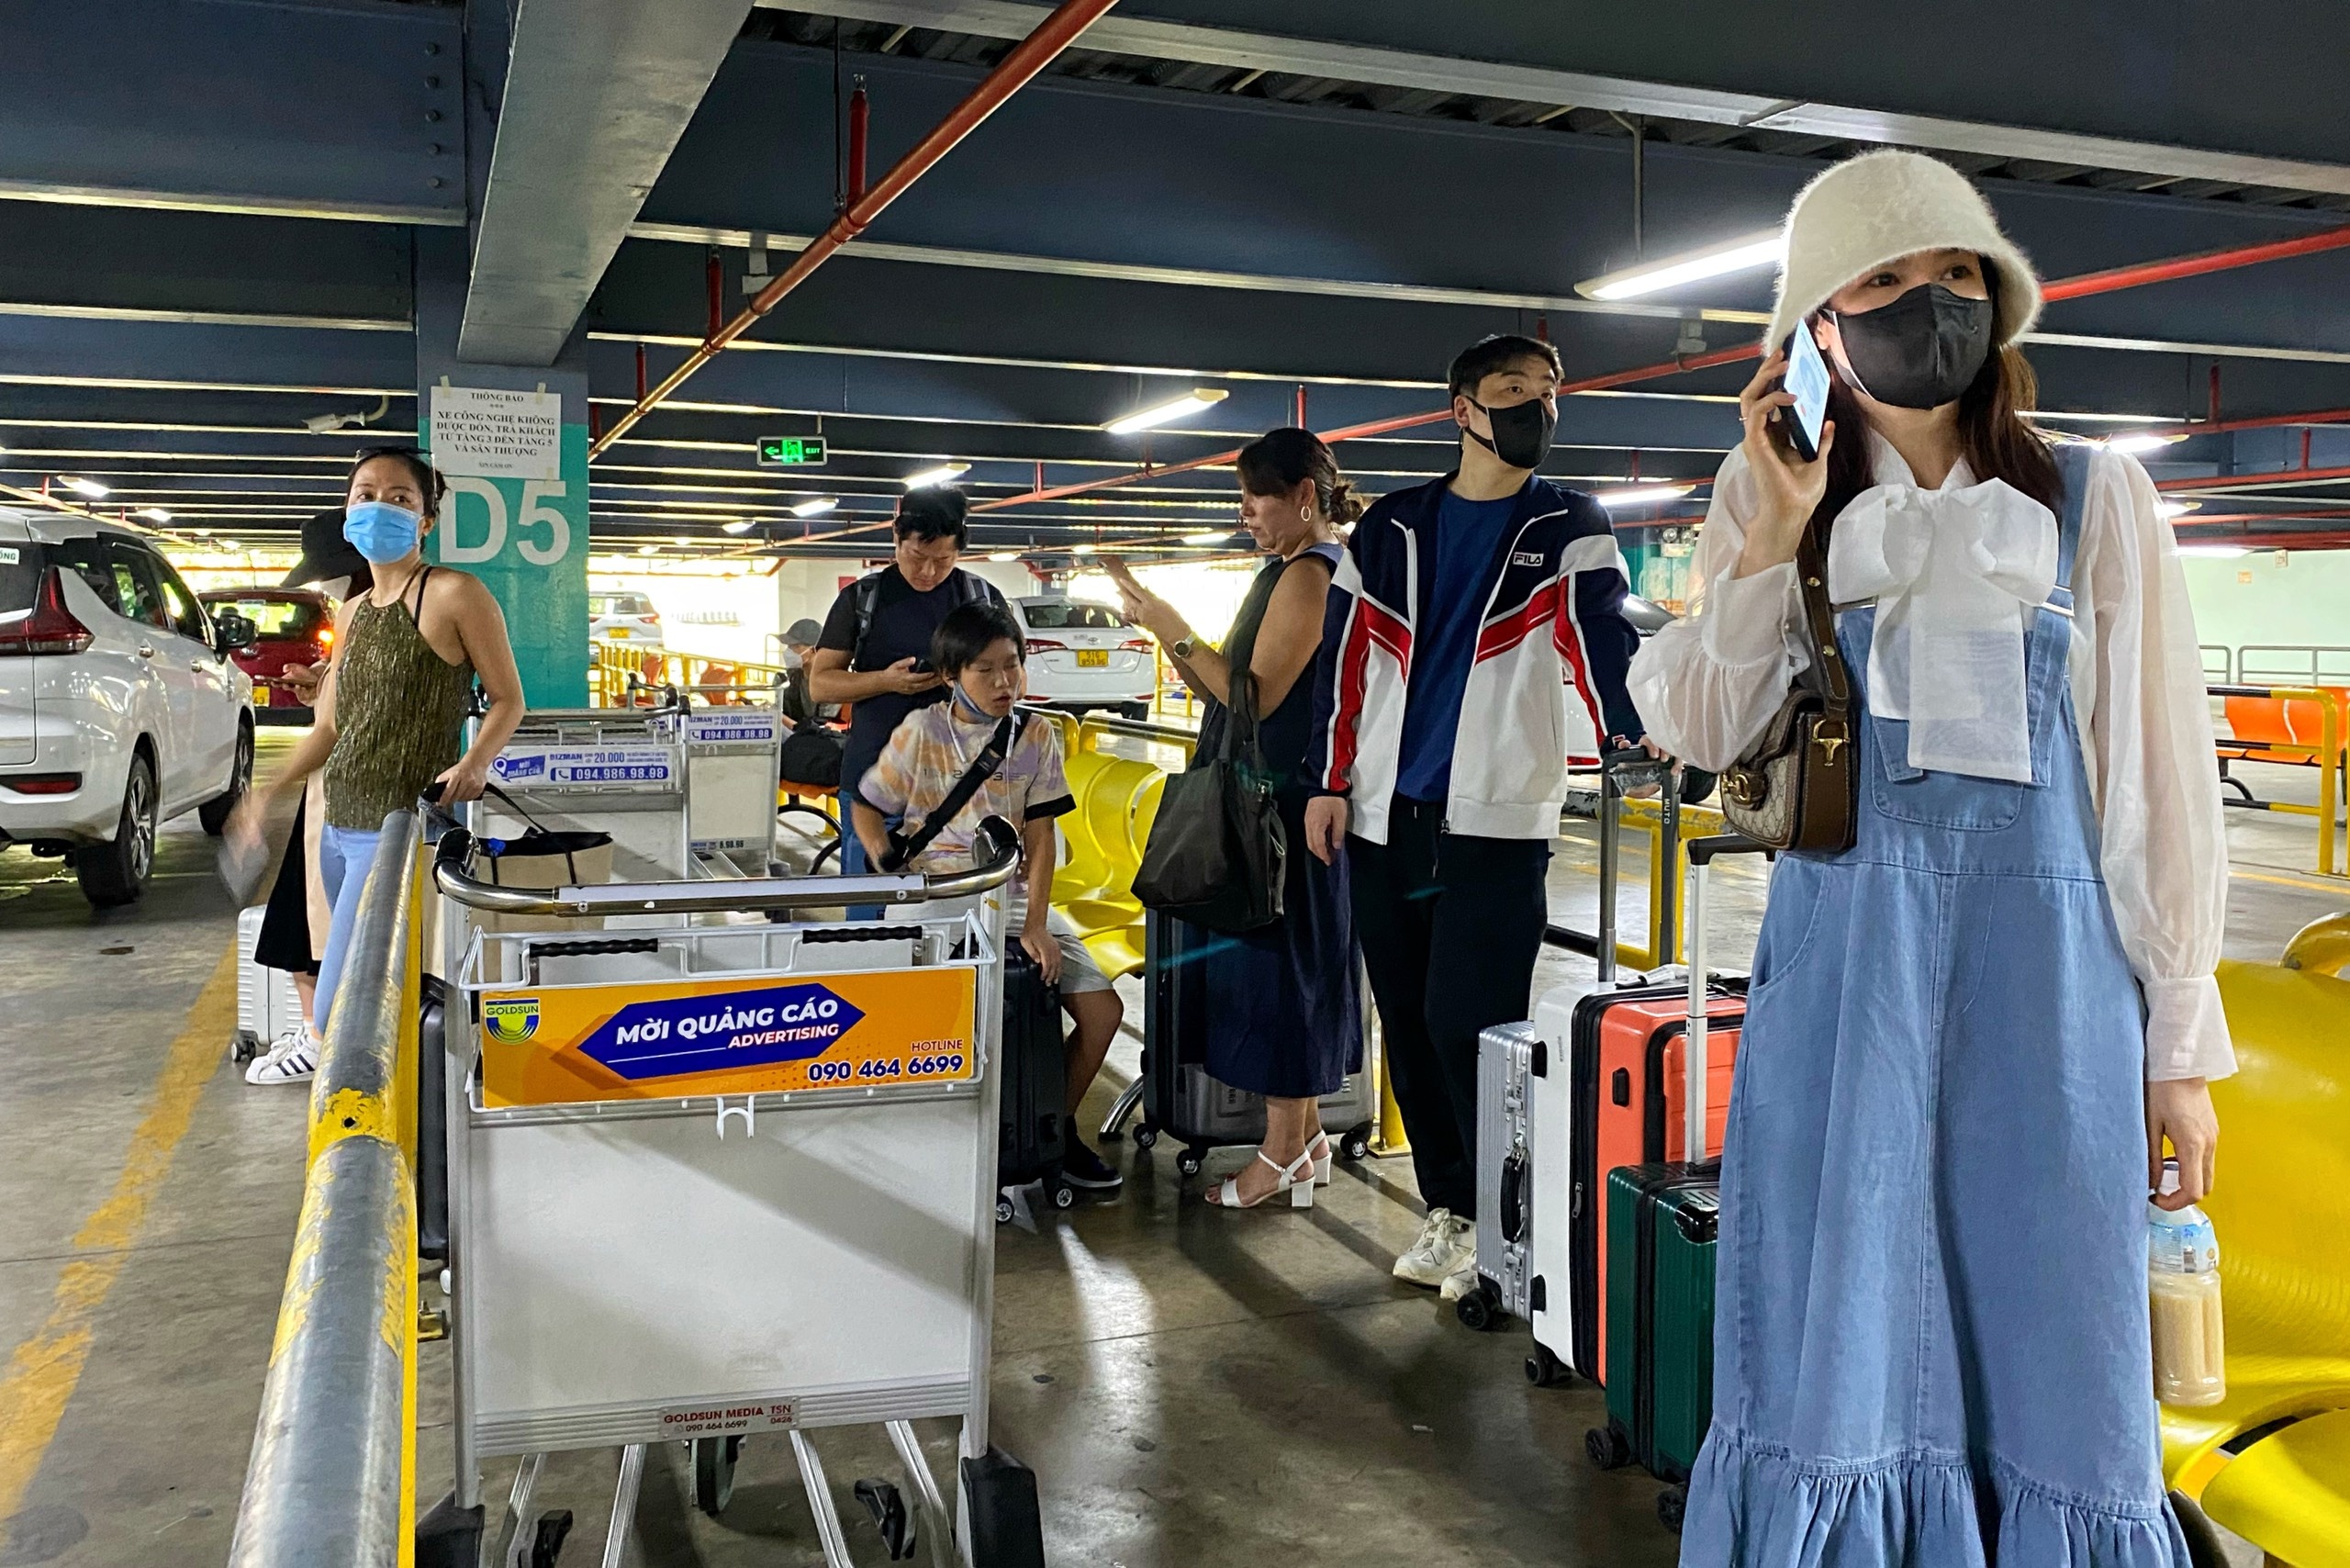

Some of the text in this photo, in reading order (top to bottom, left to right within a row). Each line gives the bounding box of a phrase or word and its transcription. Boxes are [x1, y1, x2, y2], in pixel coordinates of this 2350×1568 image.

[470, 391, 503, 401] THÔNG
[438, 410, 452, 419] XE
[453, 410, 484, 420] CÔNG
[518, 414, 554, 425] KHÔNG
[471, 443, 491, 454] SÂN
[439, 477, 570, 566] D5
[1514, 554, 1541, 565] FILA
[549, 753, 582, 761] BIZMAN
[594, 752, 625, 763] 20.000
[576, 767, 664, 780] 094.986.98.98
[486, 1004, 540, 1016] GOLDSUN
[616, 995, 839, 1047] MỜI QUẢNG CÁO
[728, 1024, 840, 1049] ADVERTISING
[911, 1039, 963, 1054] HOTLINE
[808, 1055, 964, 1081] 090 464 6699
[664, 1406, 765, 1424] GOLDSUN MEDIA
[769, 1405, 792, 1415] TSN
[686, 1420, 748, 1432] 090 464 6699
